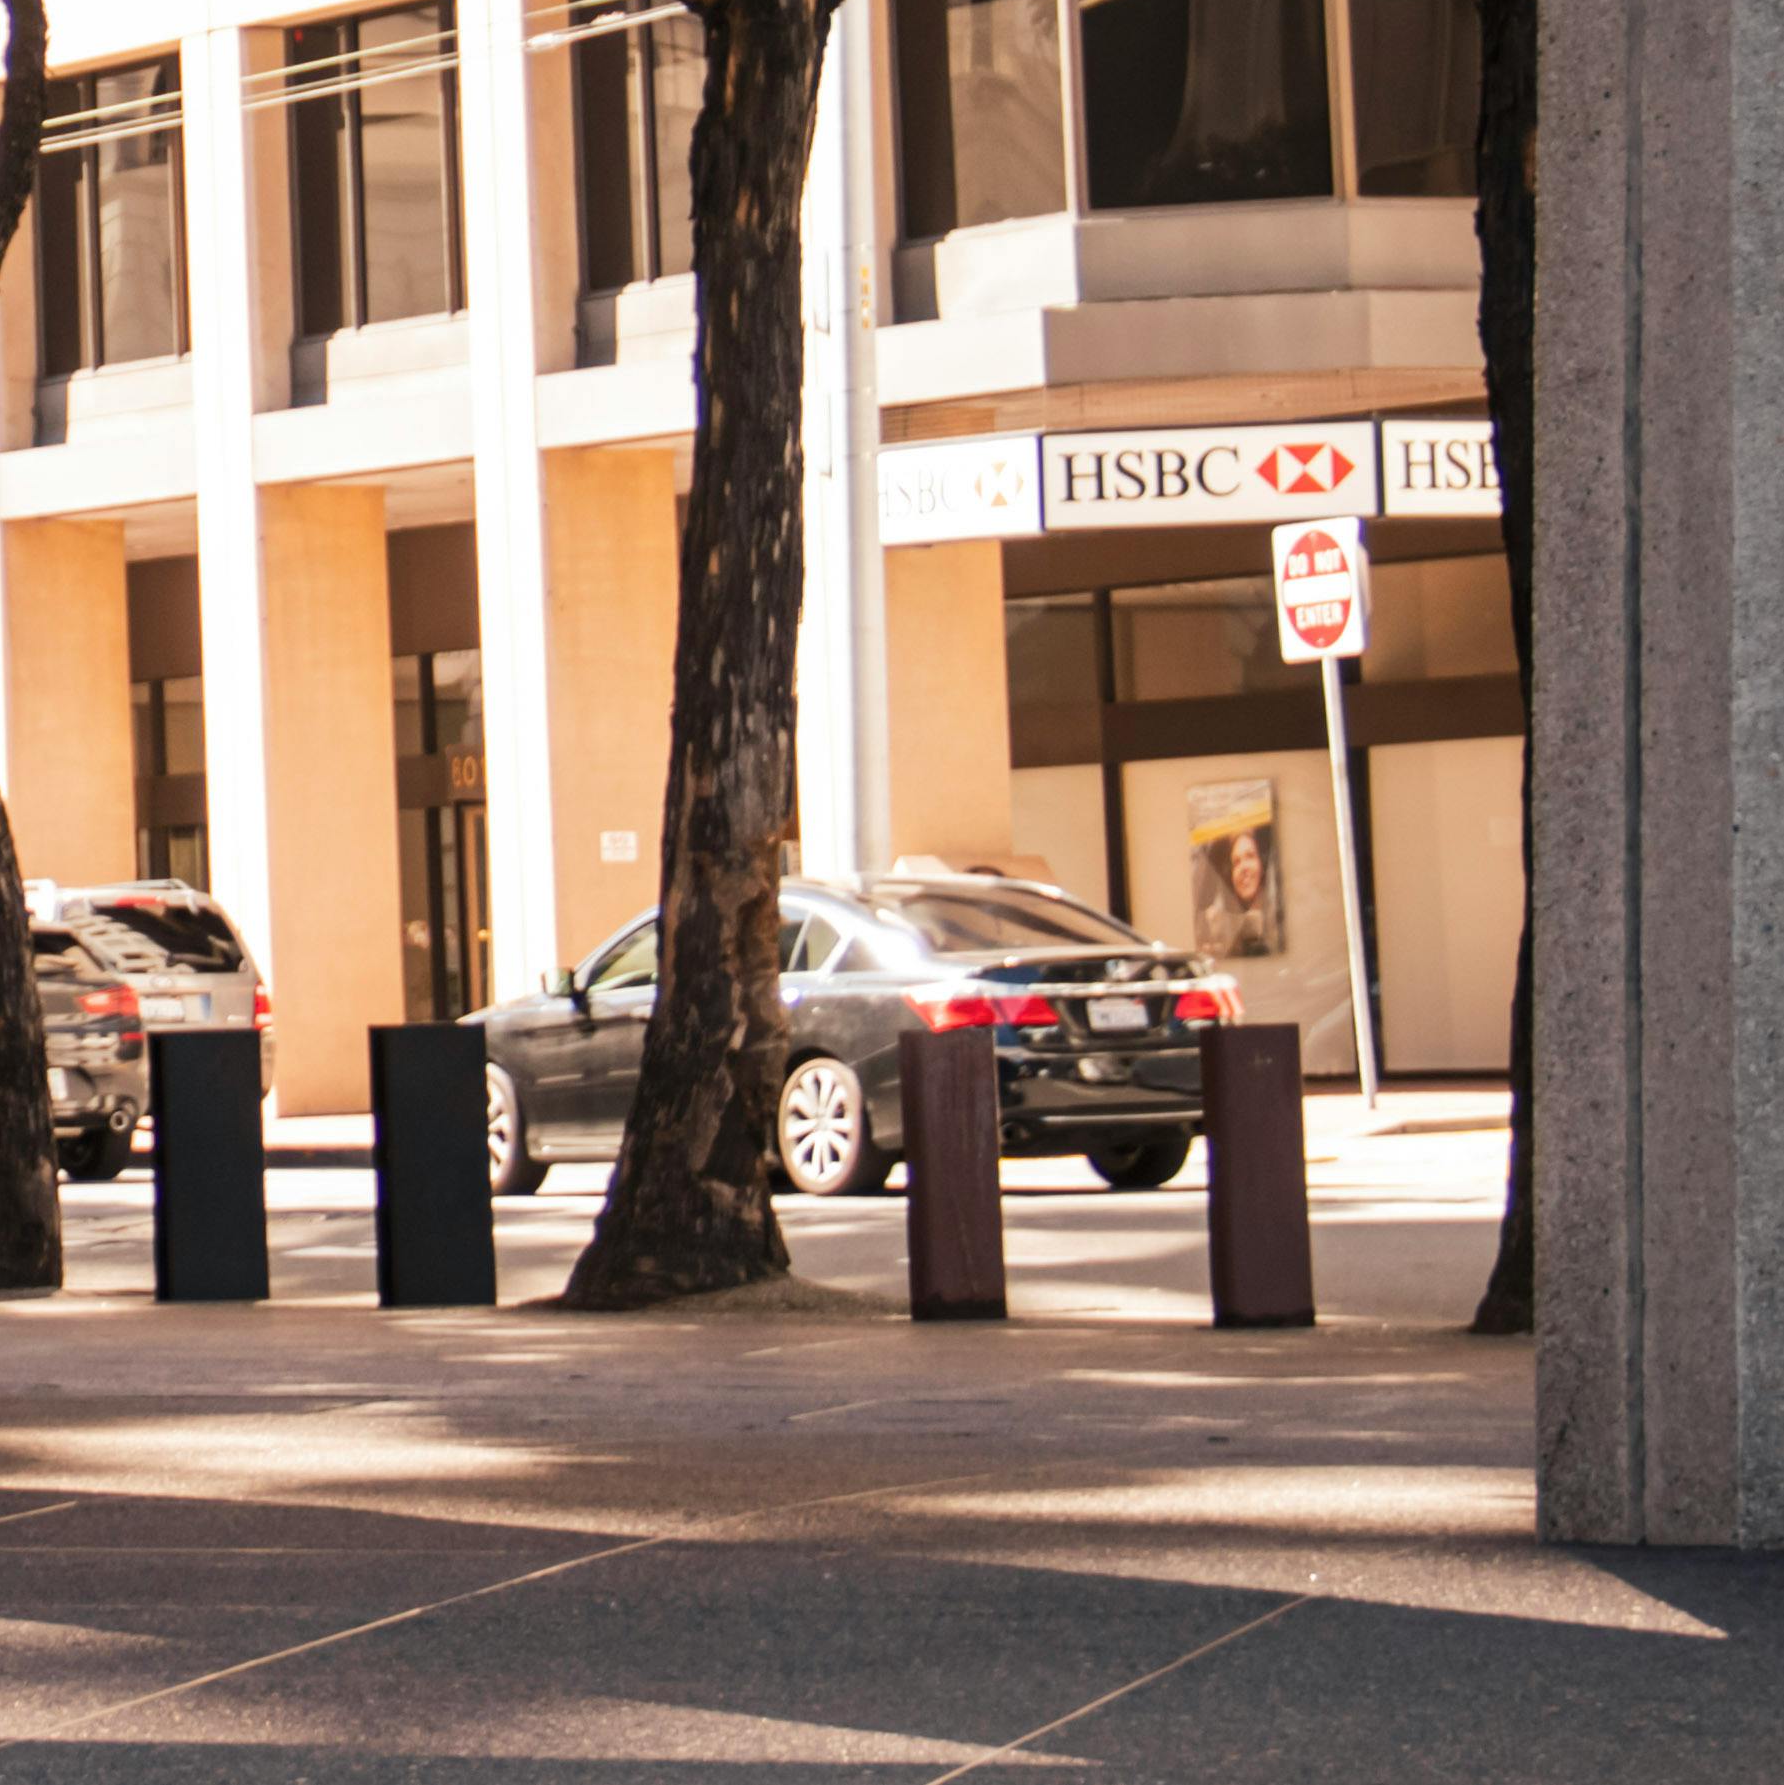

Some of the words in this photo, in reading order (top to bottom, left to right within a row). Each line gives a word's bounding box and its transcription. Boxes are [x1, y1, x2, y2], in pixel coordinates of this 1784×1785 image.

[1059, 445, 1242, 502] HSBC
[1288, 552, 1309, 577] DO
[1314, 547, 1342, 573] NOT
[1295, 600, 1345, 630] ENTER
